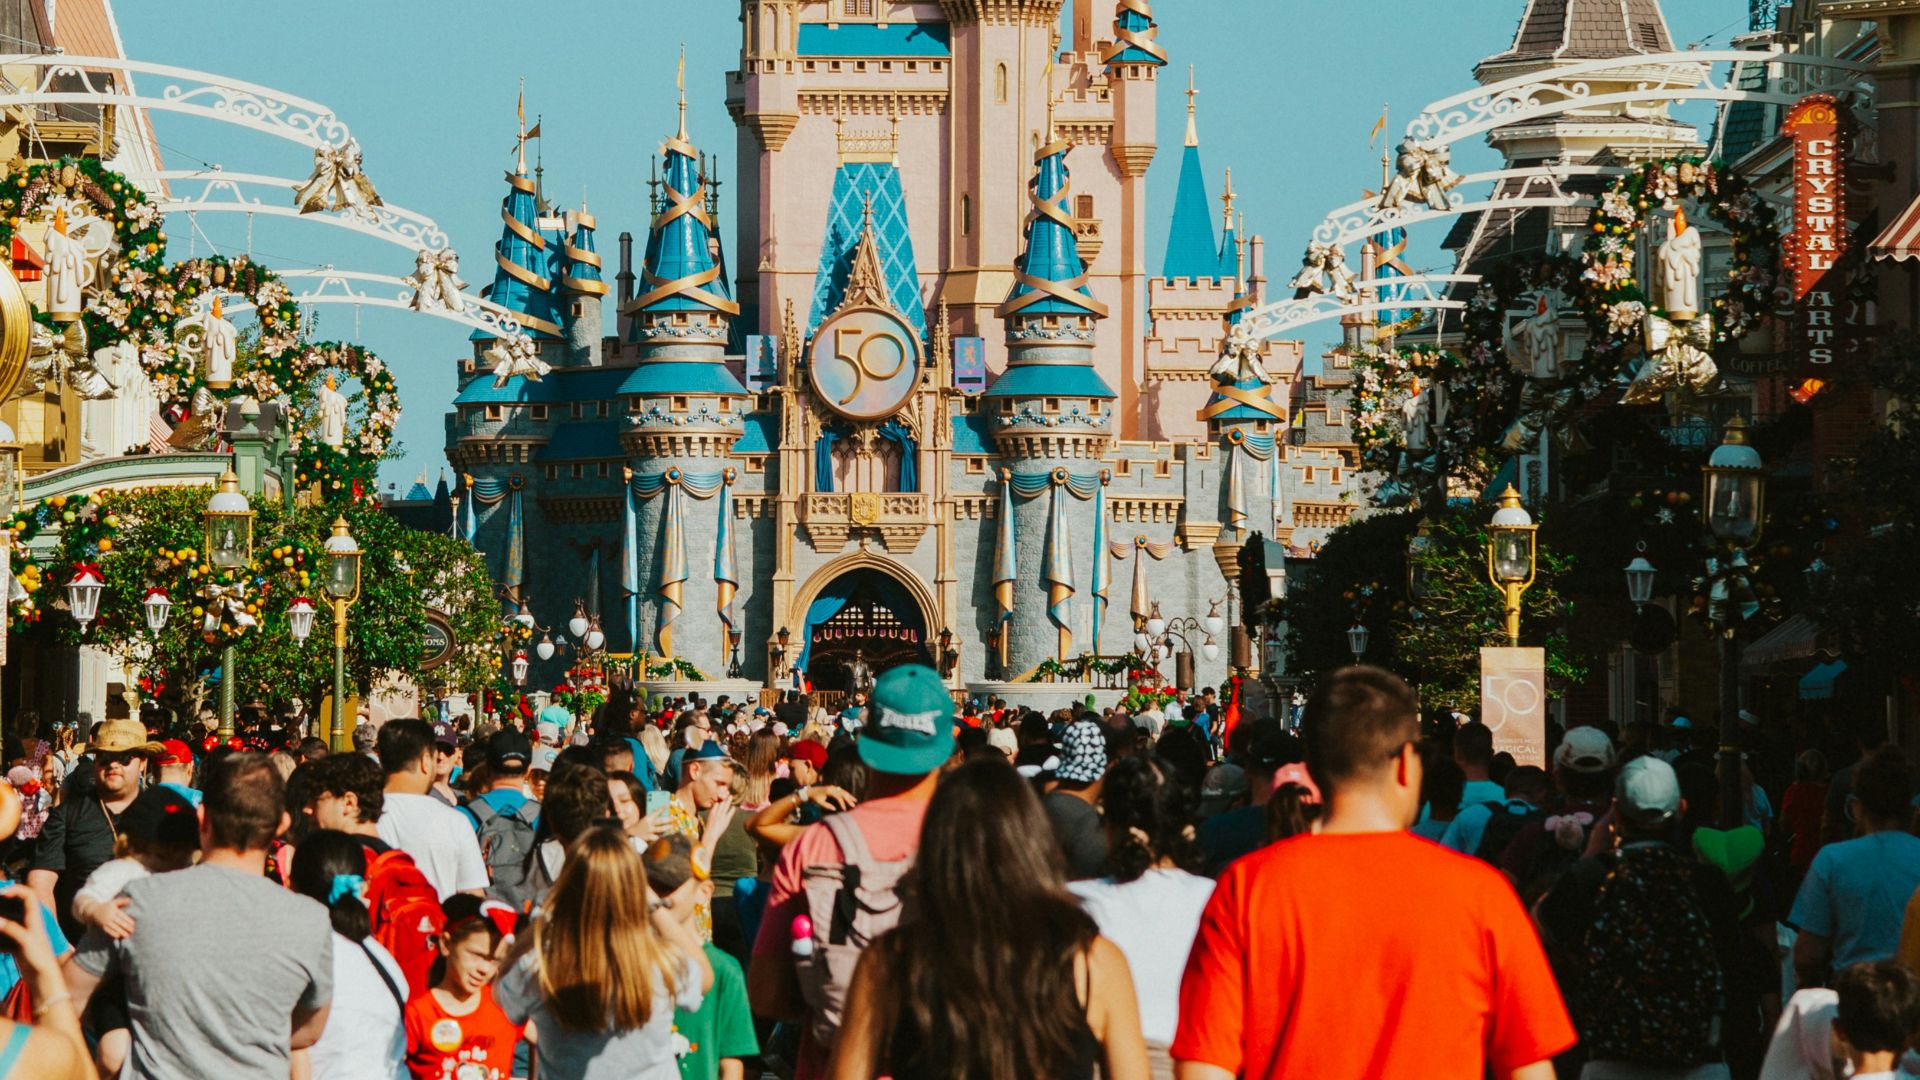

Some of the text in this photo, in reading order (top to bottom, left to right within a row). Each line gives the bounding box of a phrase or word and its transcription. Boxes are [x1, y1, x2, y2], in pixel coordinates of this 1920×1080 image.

[1806, 140, 1834, 364] CRYSTAL ARTS
[835, 328, 907, 405] 50
[1730, 357, 1786, 374] COFFEE
[1486, 676, 1539, 732] 50
